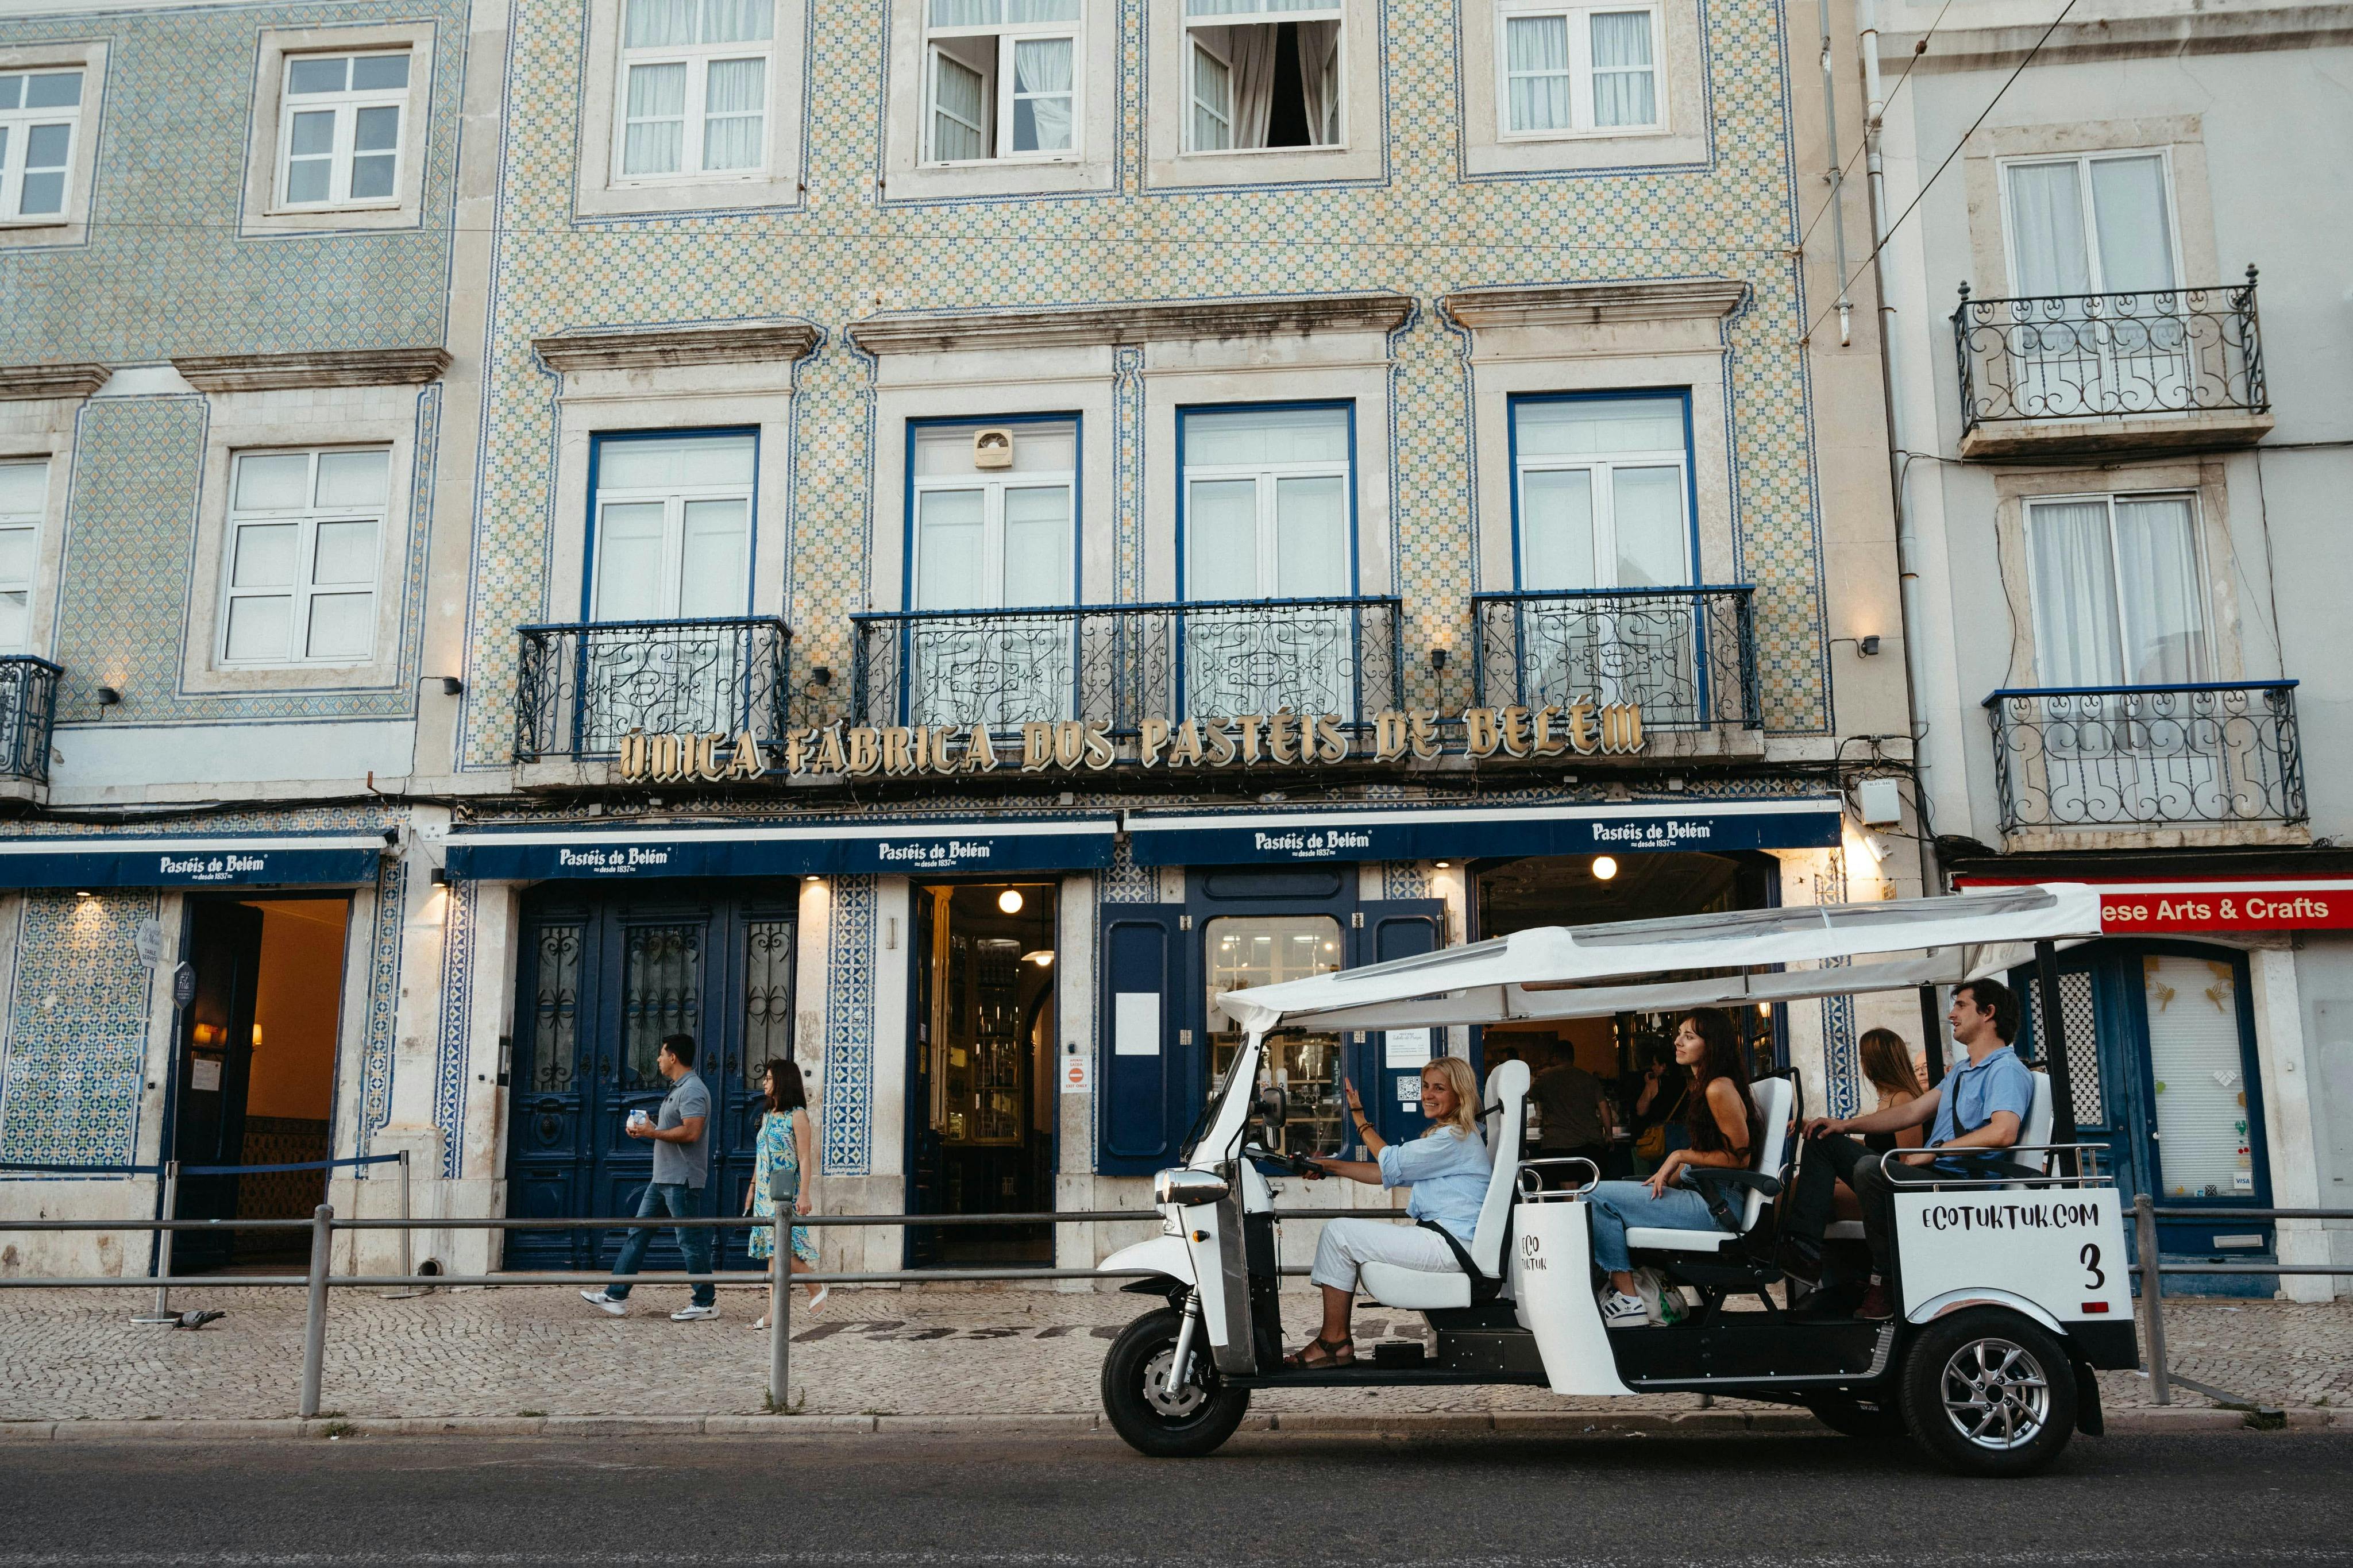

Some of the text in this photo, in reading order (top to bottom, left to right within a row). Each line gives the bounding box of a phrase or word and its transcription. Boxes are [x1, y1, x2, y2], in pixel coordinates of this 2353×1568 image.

[620, 693, 1645, 784] ÚNICA FÁBRICA DOS PASTÉIS DE BELÉM
[1592, 822, 1643, 841] Pastéis
[1646, 824, 1663, 839] de
[1255, 832, 1303, 850] Pastéis
[1307, 833, 1324, 849] de
[1656, 839, 1671, 847] 1837
[560, 848, 605, 866] Pastéis
[608, 849, 624, 865] de
[878, 843, 926, 860] Pastéis
[929, 843, 946, 859] de
[160, 856, 205, 873] Pastéis
[207, 857, 223, 872] de
[938, 859, 951, 867] 1837
[2156, 899, 2212, 920] Arts
[2219, 898, 2239, 920] &
[2246, 897, 2329, 920] Crafts
[142, 953, 158, 963] SERVICE
[145, 948, 156, 956] TABLE
[1922, 1203, 2099, 1230] ECOTUKTUK.COM
[1522, 1235, 1540, 1256] ECO
[2080, 1243, 2105, 1290] 3
